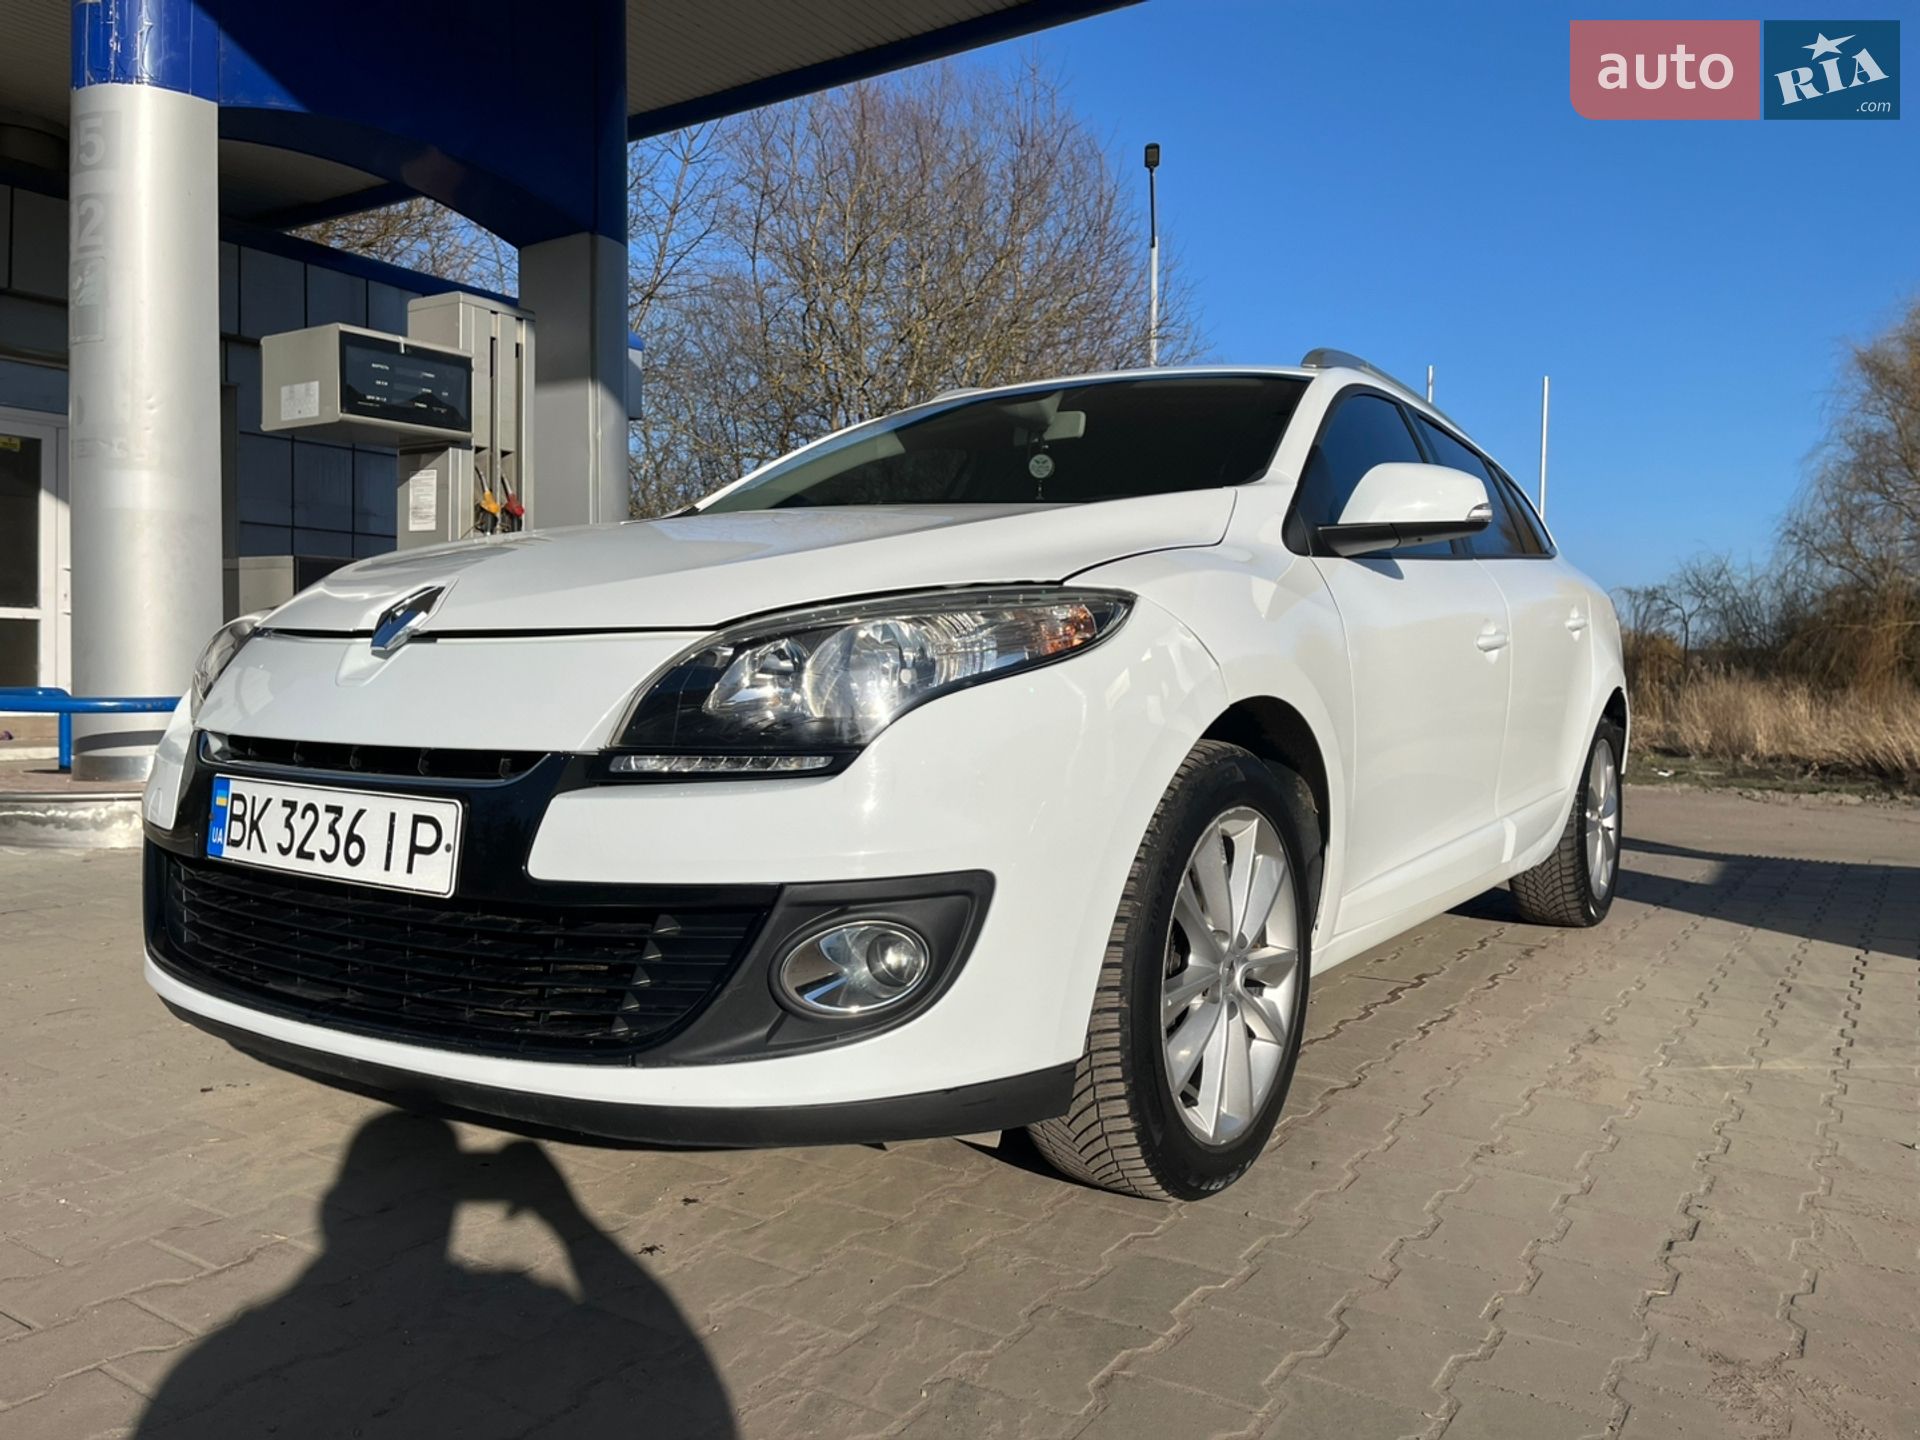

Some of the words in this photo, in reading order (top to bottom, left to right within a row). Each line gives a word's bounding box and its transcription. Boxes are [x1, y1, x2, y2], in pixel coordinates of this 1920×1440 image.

[211, 827, 223, 844] UA
[226, 793, 272, 854] BK
[276, 799, 367, 867] 3236
[384, 812, 443, 874] IP
